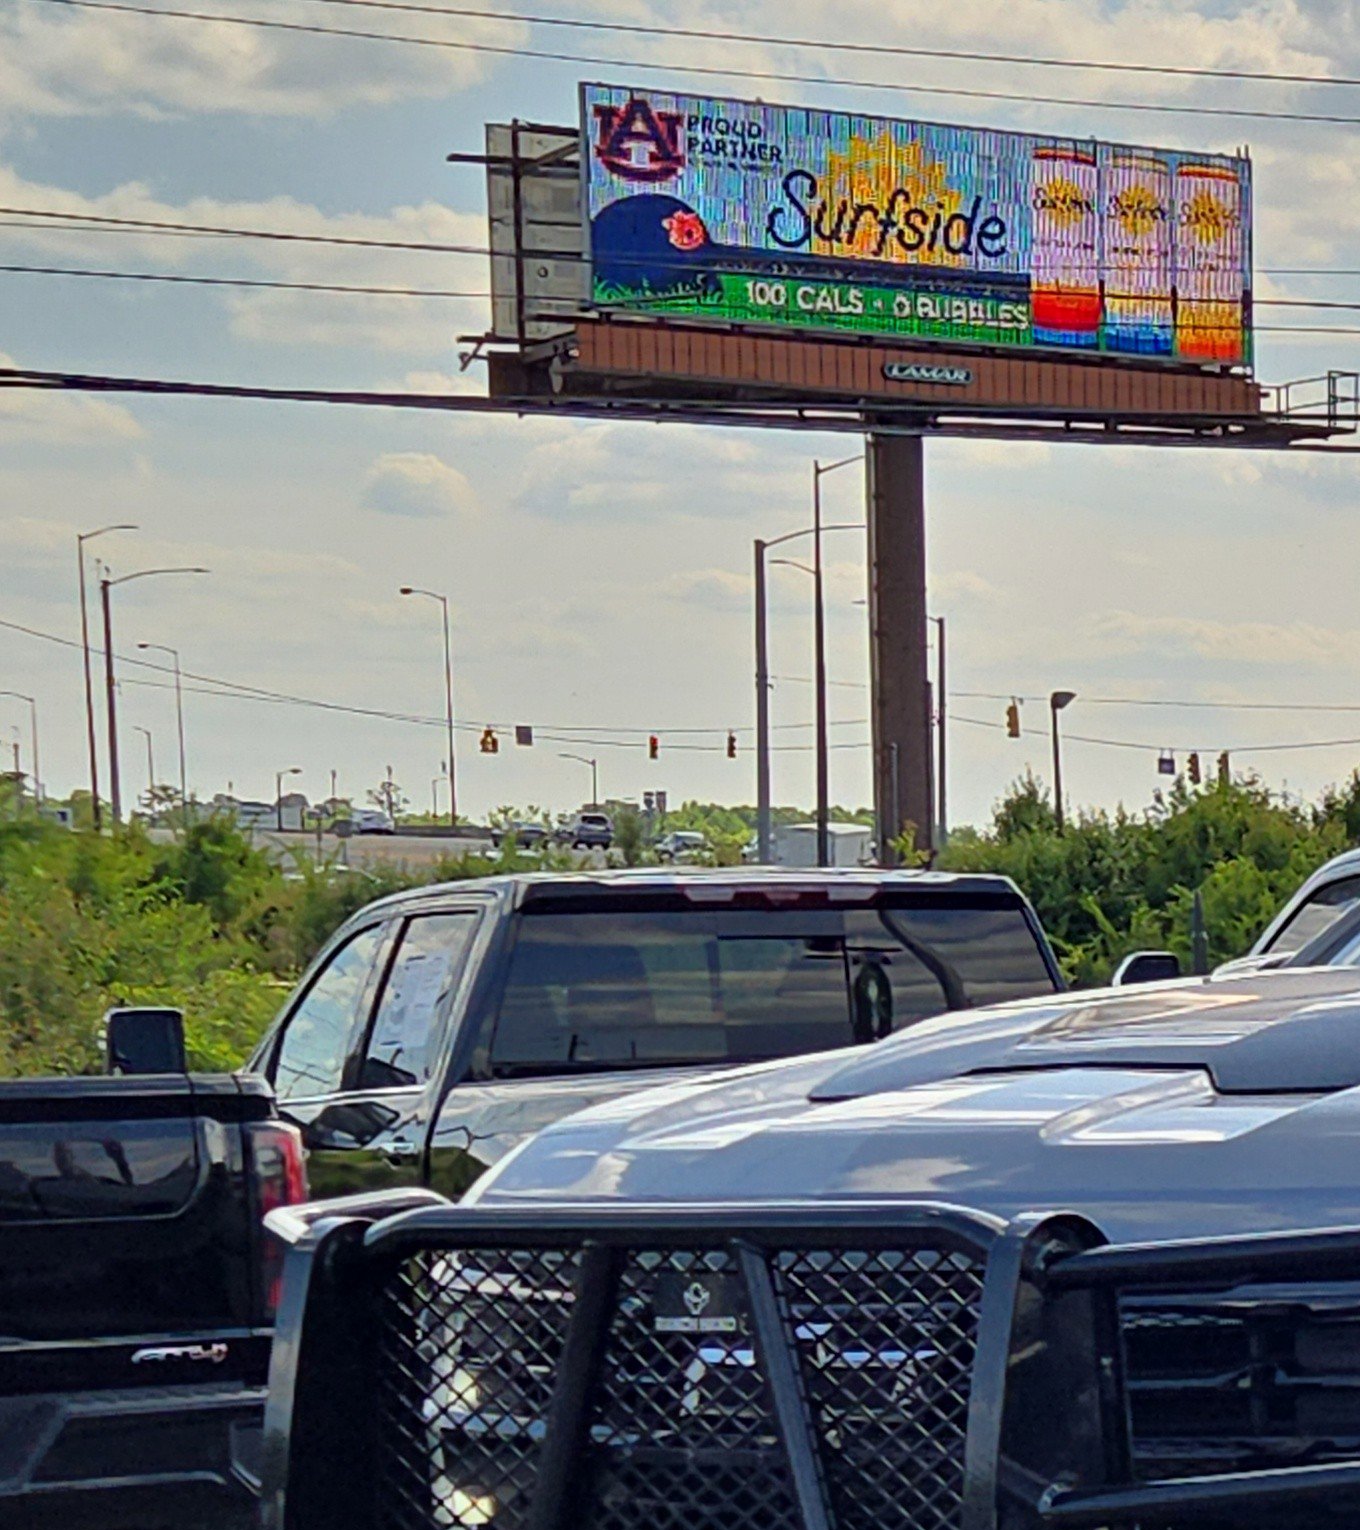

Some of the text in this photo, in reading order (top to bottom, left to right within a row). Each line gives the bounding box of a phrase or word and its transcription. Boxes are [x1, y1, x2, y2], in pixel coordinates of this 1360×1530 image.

[687, 114, 763, 139] PROUD
[687, 137, 783, 163] PARTNER
[767, 170, 1007, 257] Surfside
[746, 281, 786, 306] 100
[797, 286, 864, 315] CALS
